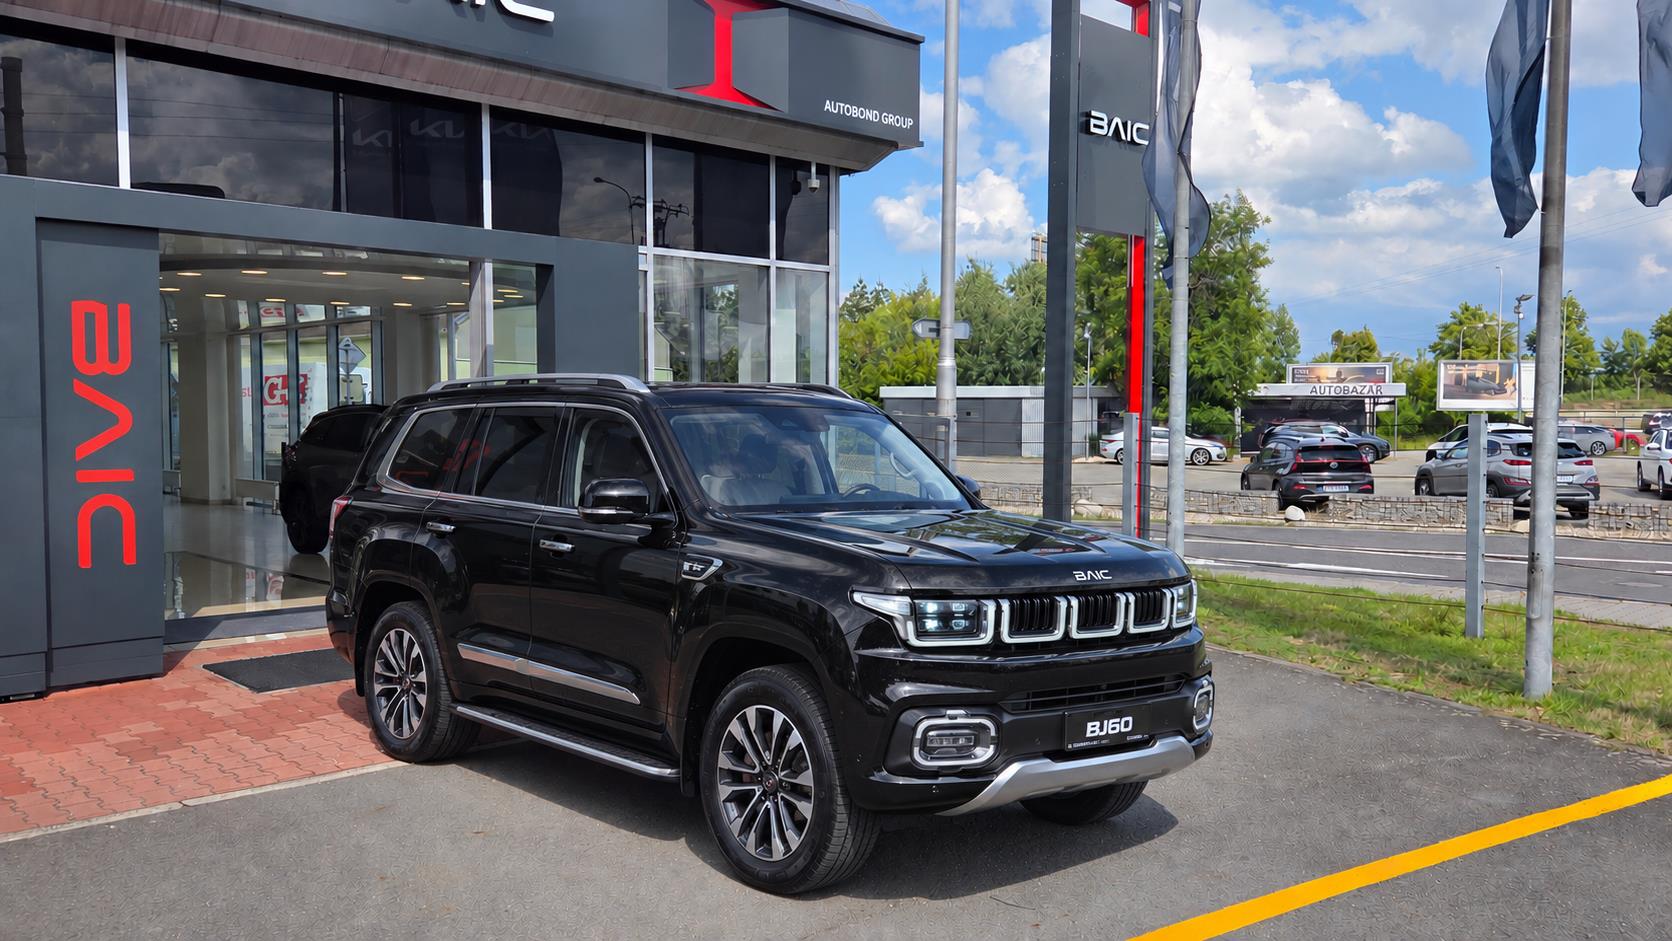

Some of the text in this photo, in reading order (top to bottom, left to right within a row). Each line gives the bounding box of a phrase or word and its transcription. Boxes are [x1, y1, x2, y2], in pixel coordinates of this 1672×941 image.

[824, 99, 914, 129] AUTOBOND GROUP
[1090, 110, 1150, 146] BAIC
[1309, 385, 1383, 395] AUTOBAZAR
[72, 300, 137, 569] BAIC
[1072, 569, 1112, 581] BAIC
[1085, 716, 1134, 738] BJ60
